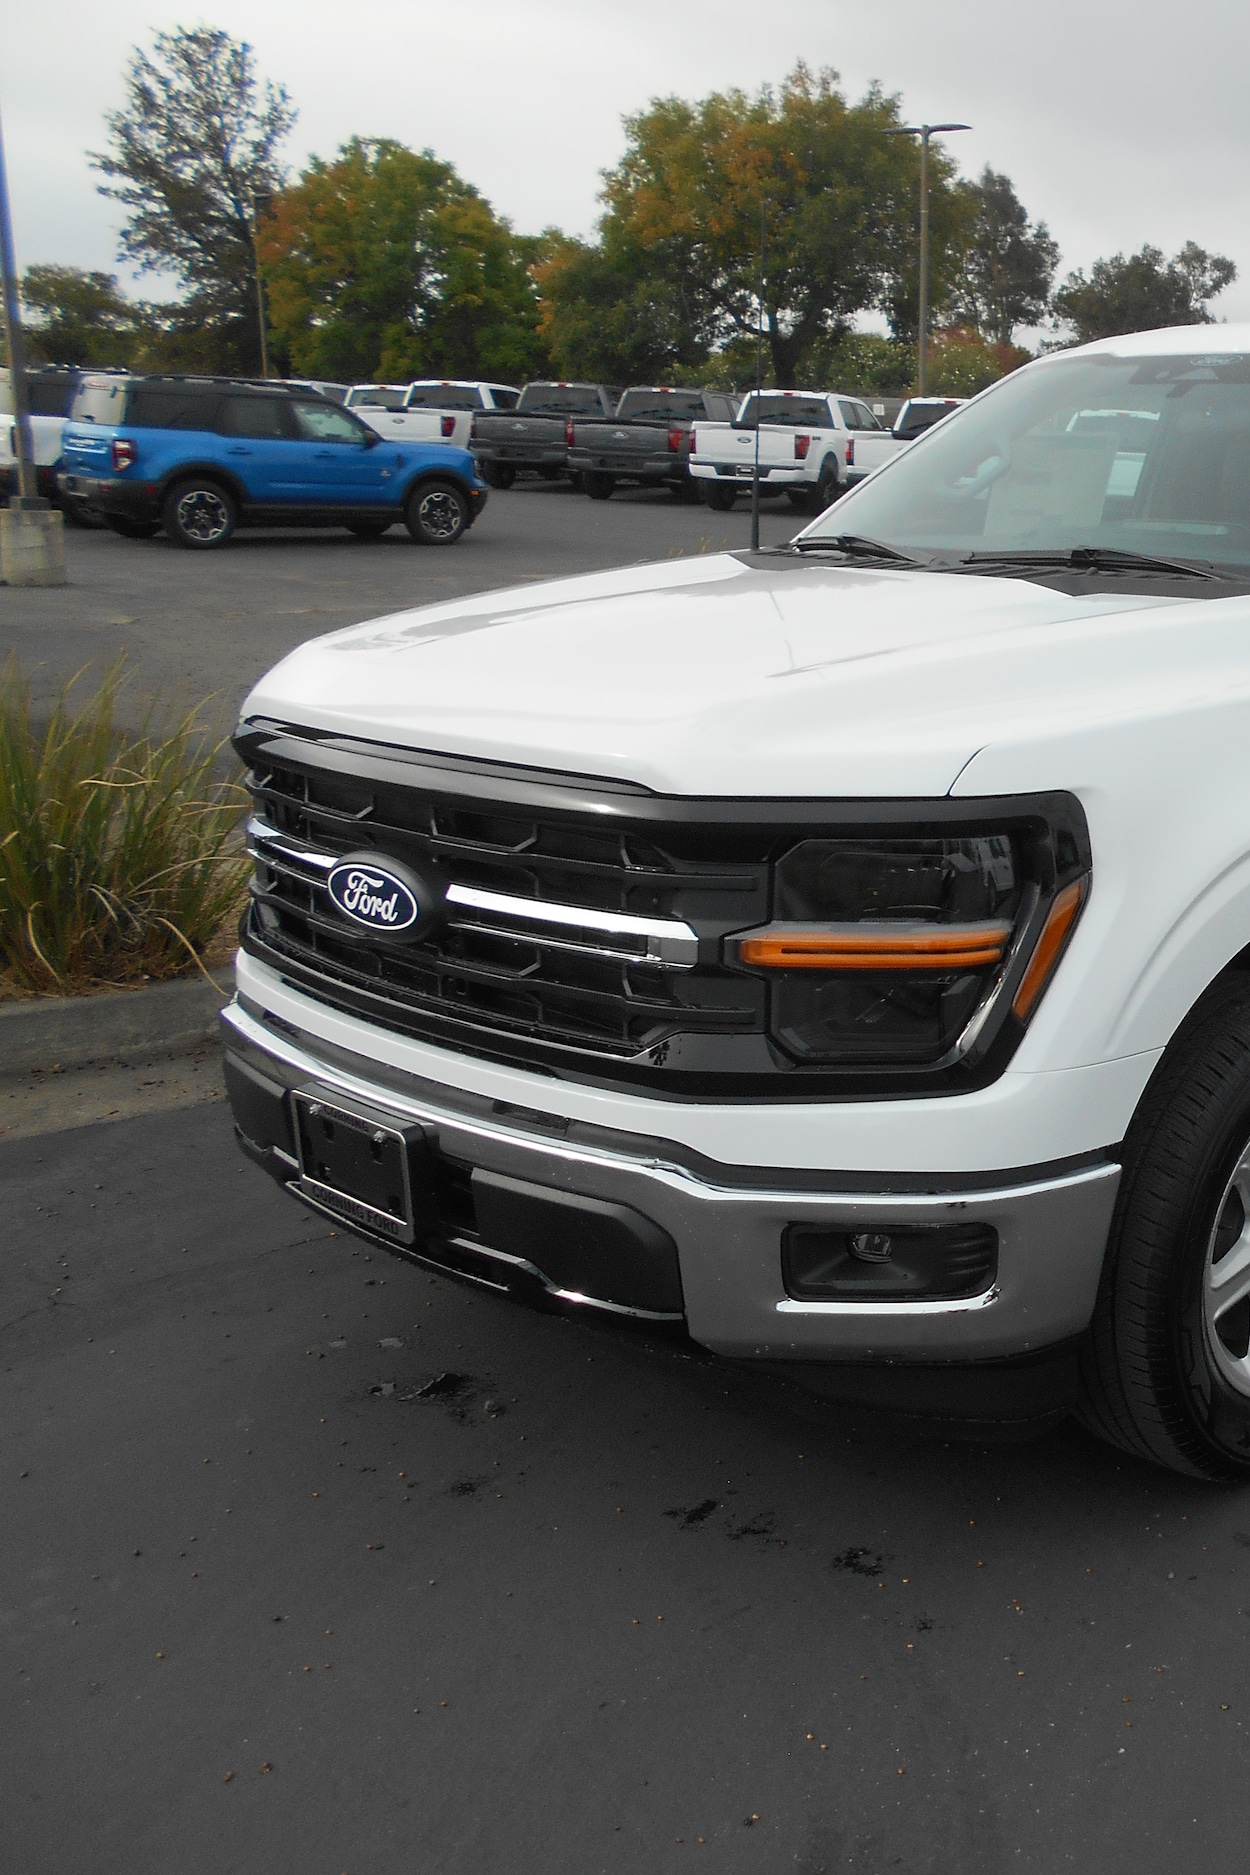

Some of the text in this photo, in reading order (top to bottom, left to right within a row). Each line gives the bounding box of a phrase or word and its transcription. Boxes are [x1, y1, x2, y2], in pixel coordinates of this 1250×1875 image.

[344, 871, 398, 922] Ford
[313, 1184, 399, 1235] CORNING FORD
